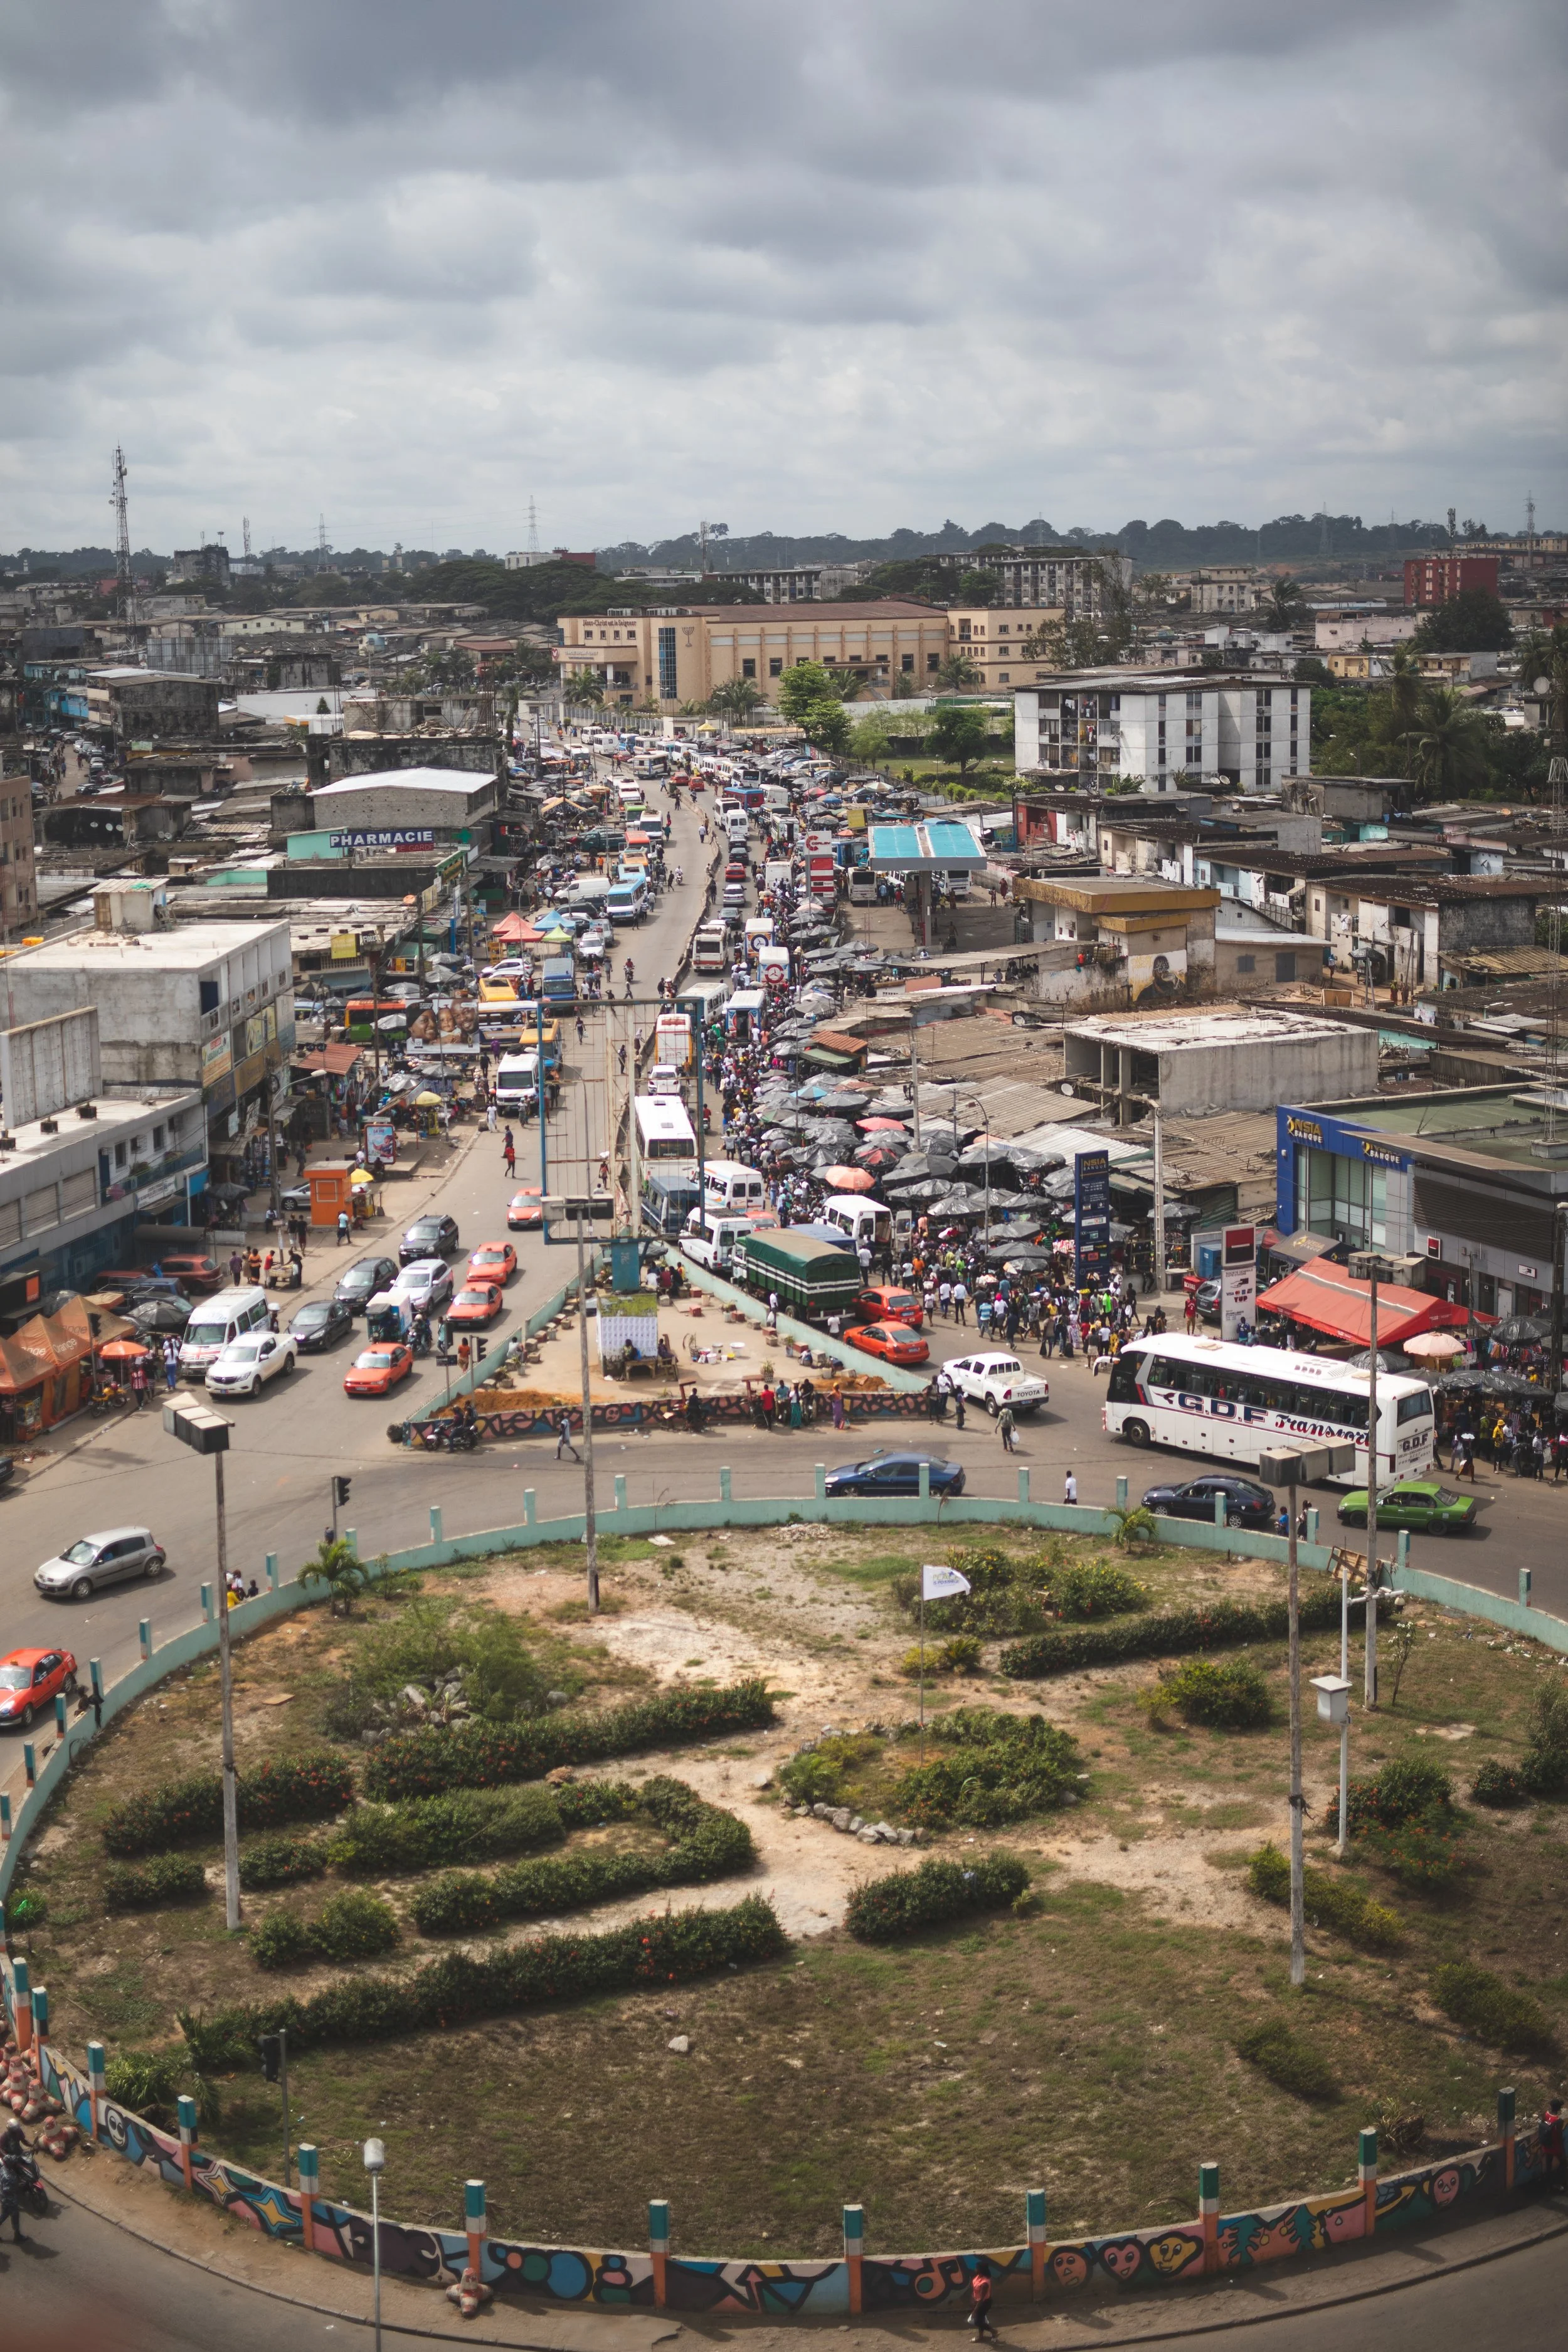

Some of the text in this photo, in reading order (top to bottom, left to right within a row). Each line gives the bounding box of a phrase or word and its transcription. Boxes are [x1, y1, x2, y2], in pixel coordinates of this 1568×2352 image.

[331, 831, 432, 847] PHARMACIE
[408, 843, 434, 851] GARDE
[1295, 1119, 1322, 1135] NSIA
[1294, 1130, 1323, 1143] BANQUE
[1083, 1158, 1106, 1167] NSIA
[1370, 1150, 1401, 1164] BANQUE
[53, 1338, 77, 1353] Orange
[1179, 1393, 1268, 1424] G.D.F
[1403, 1433, 1428, 1453] G.D.F
